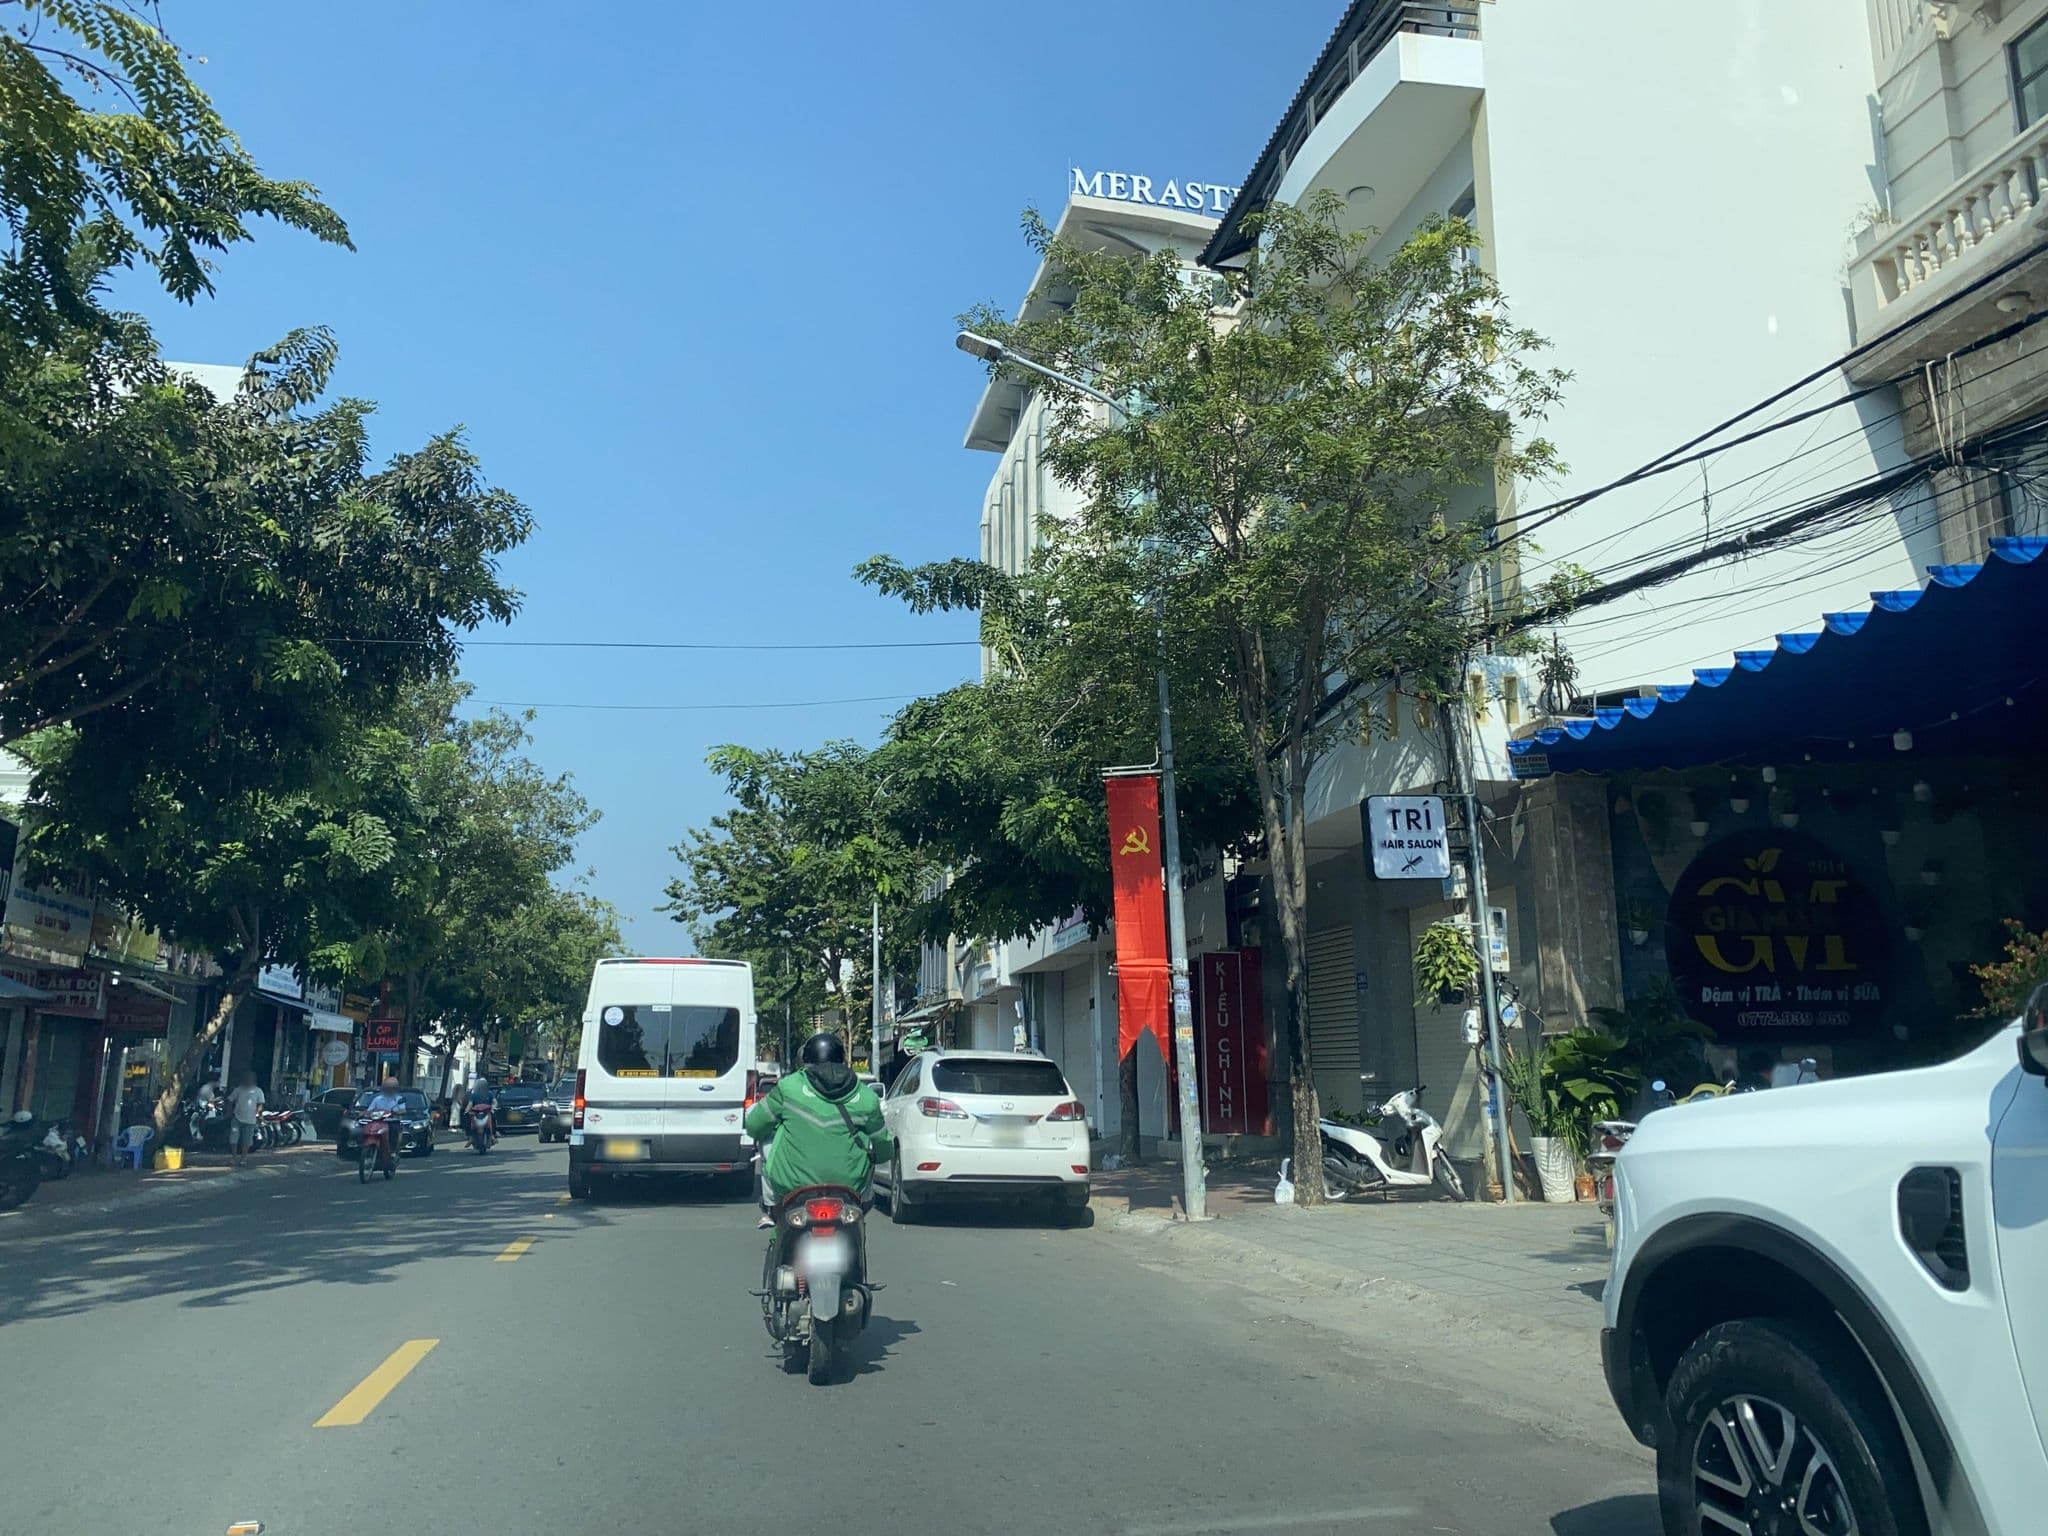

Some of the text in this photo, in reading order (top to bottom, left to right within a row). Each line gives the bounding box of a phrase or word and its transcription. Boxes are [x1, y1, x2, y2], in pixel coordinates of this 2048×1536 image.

[1386, 799, 1431, 831] TRÍ
[1407, 839, 1442, 849] SALON
[1218, 1037, 1232, 1119] CHINH
